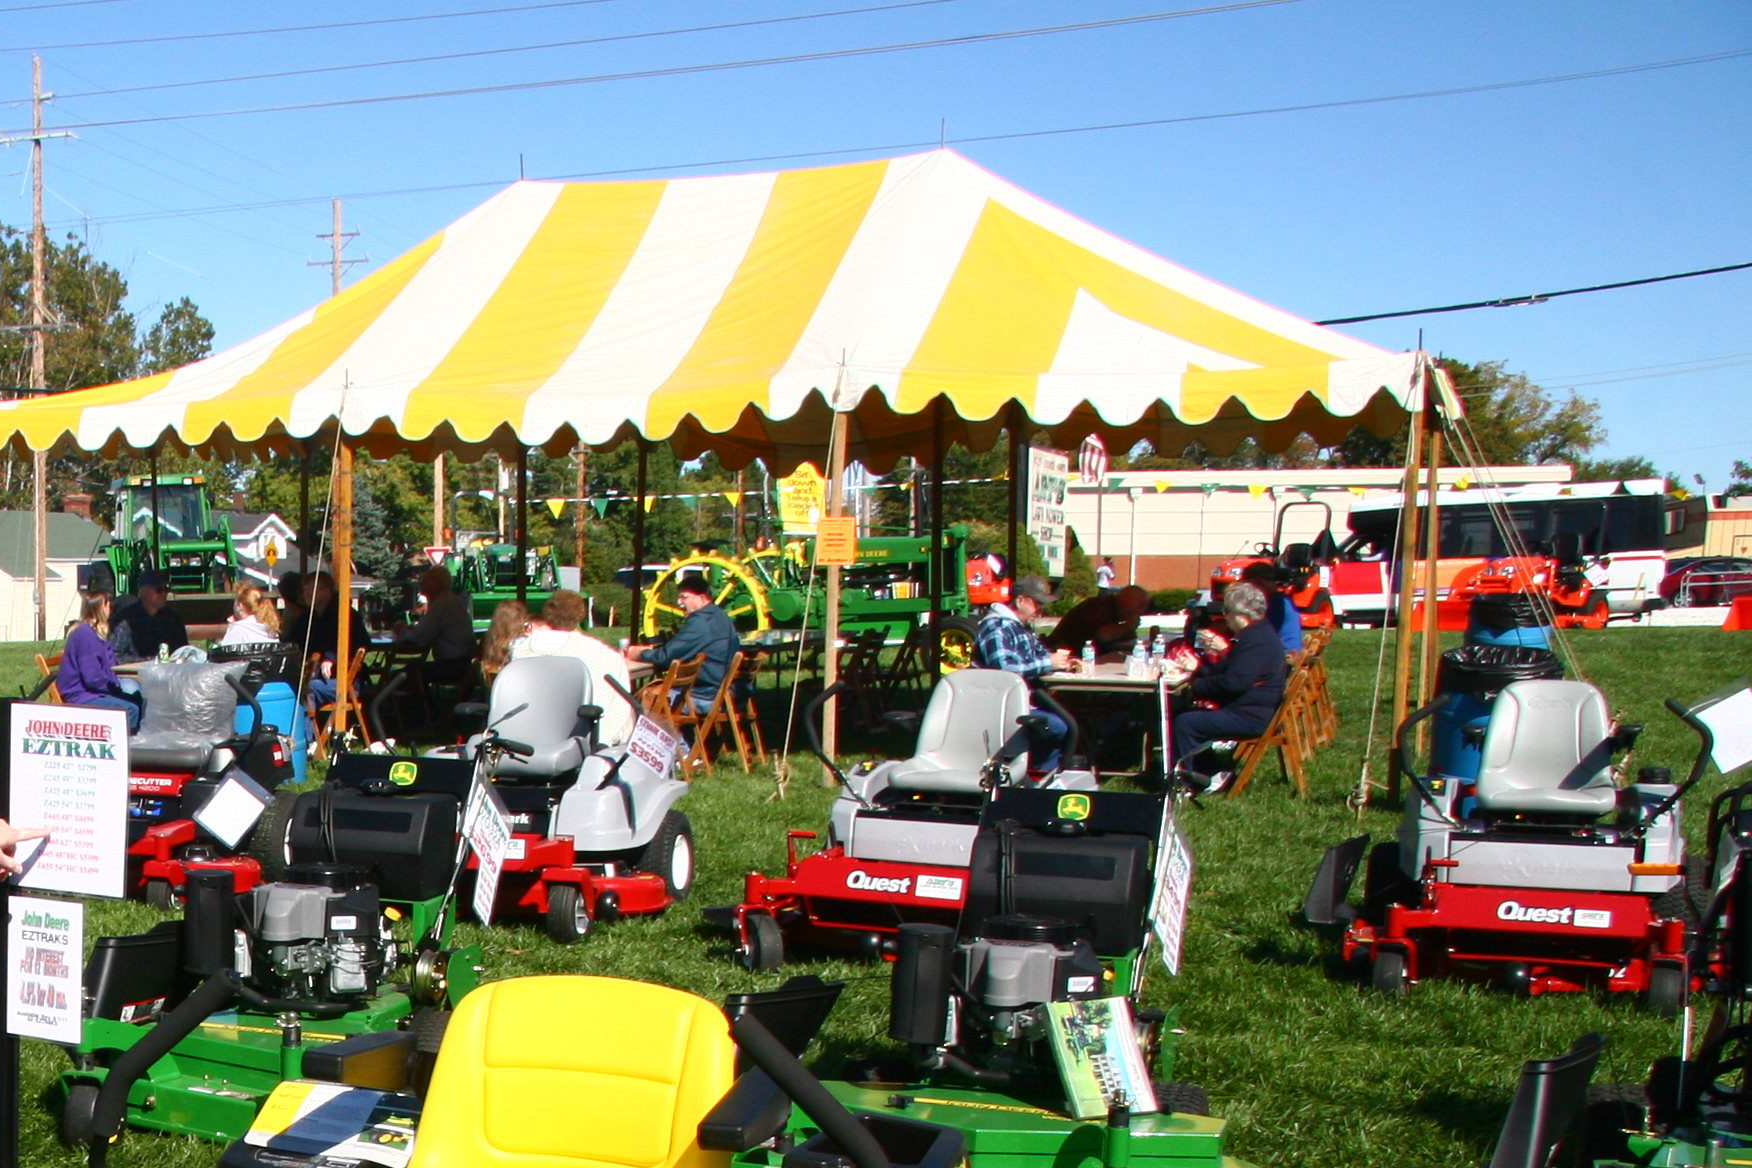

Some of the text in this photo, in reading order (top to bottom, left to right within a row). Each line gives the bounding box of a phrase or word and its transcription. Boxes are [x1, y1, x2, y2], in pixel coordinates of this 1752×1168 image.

[25, 719, 111, 740] JOHN DEERE
[21, 738, 117, 760] EZTRAK
[629, 741, 664, 773] $3599
[846, 870, 911, 894] Quest
[21, 909, 70, 931] John Deere
[1497, 900, 1573, 924] Quest
[21, 930, 69, 945] EZTRAKS
